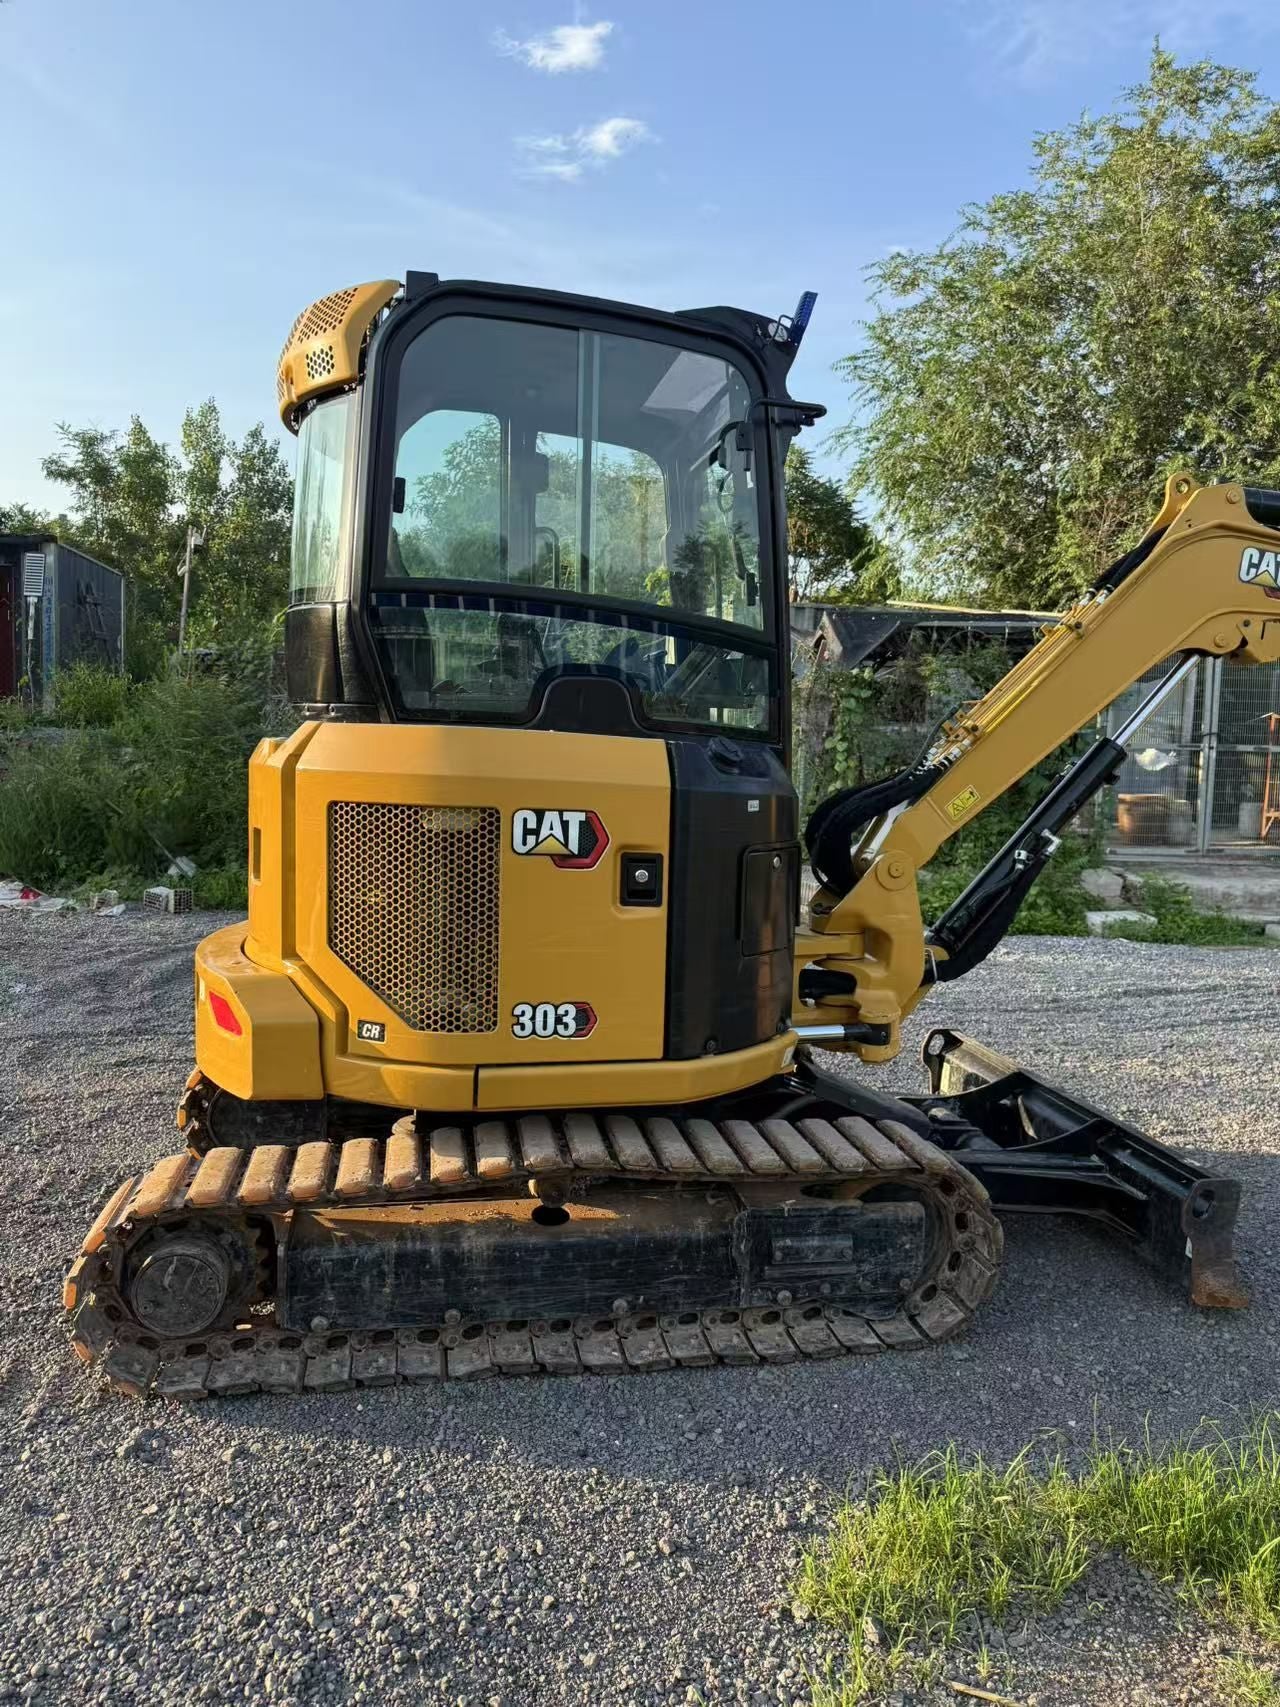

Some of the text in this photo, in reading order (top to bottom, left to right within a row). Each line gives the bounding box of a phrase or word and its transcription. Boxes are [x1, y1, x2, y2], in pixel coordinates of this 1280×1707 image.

[1239, 547, 1280, 588] CA
[512, 809, 586, 855] CAT
[362, 1023, 380, 1039] CR
[512, 1003, 577, 1037] 303
